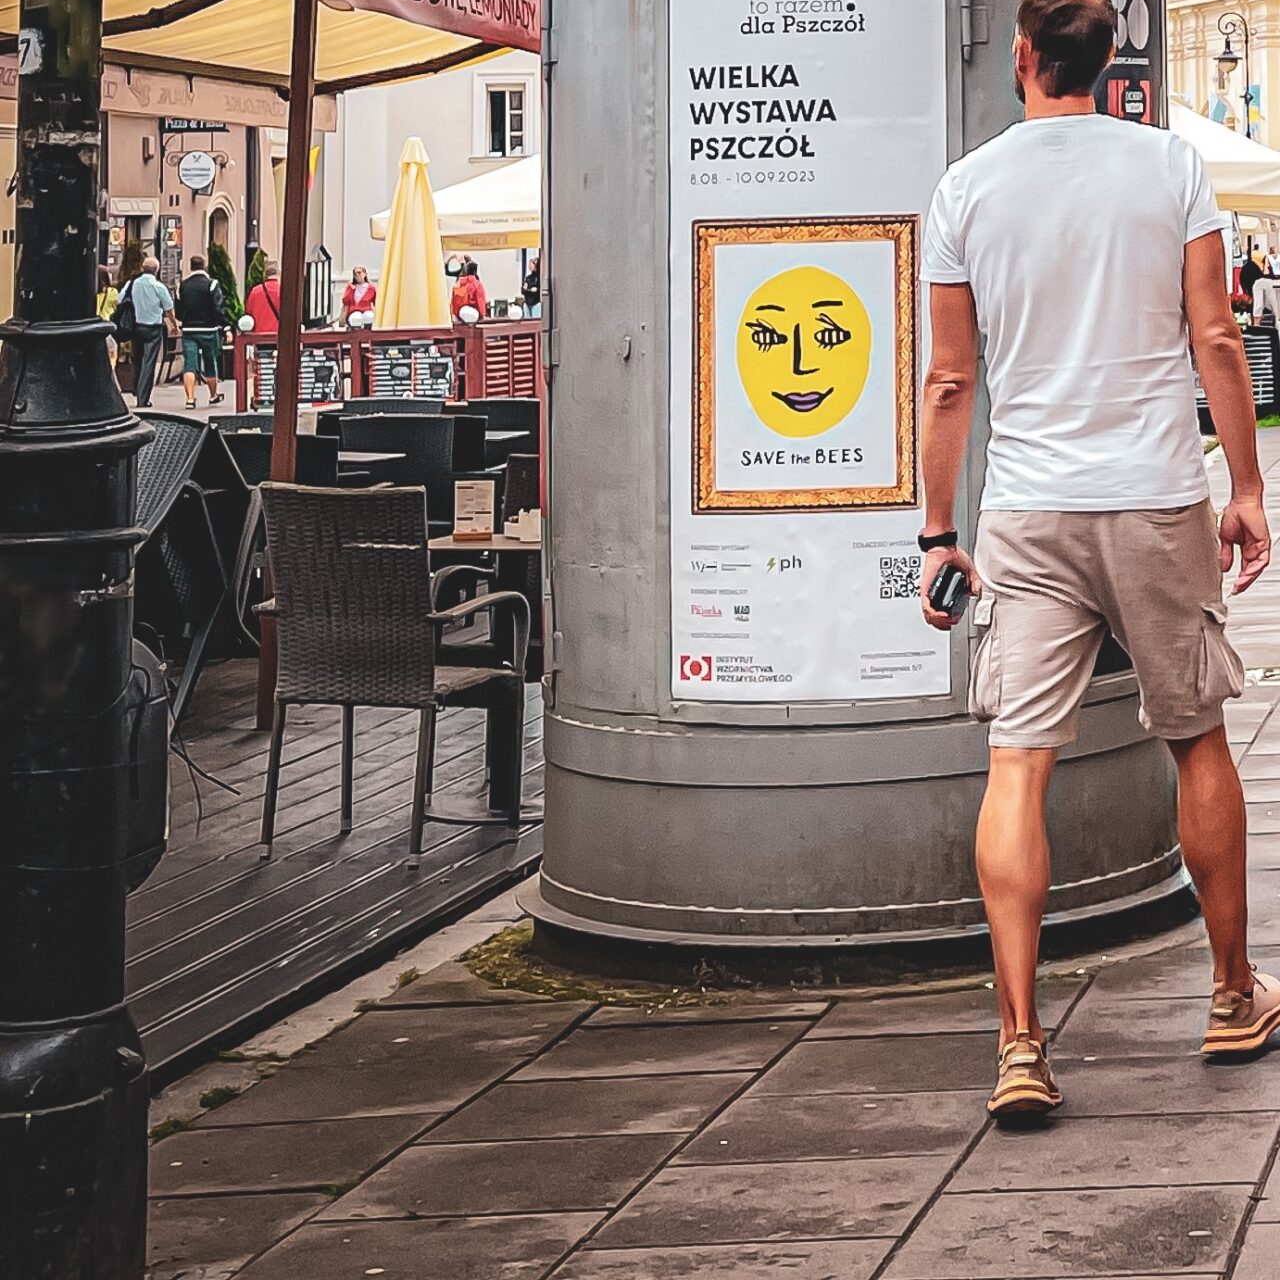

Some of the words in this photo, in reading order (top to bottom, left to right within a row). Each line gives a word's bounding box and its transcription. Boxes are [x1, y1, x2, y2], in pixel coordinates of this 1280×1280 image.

[750, 0, 769, 15] to
[775, 0, 843, 14] razem
[740, 17, 776, 35] dla
[781, 13, 866, 34] Pszczół
[688, 64, 800, 91] WIELKA
[689, 98, 837, 126] WYSTAWA
[690, 127, 816, 161] PSZCZÓŁ
[740, 450, 786, 467] SAVE
[791, 453, 811, 465] the
[815, 448, 864, 465] BEES
[780, 555, 802, 572] ph
